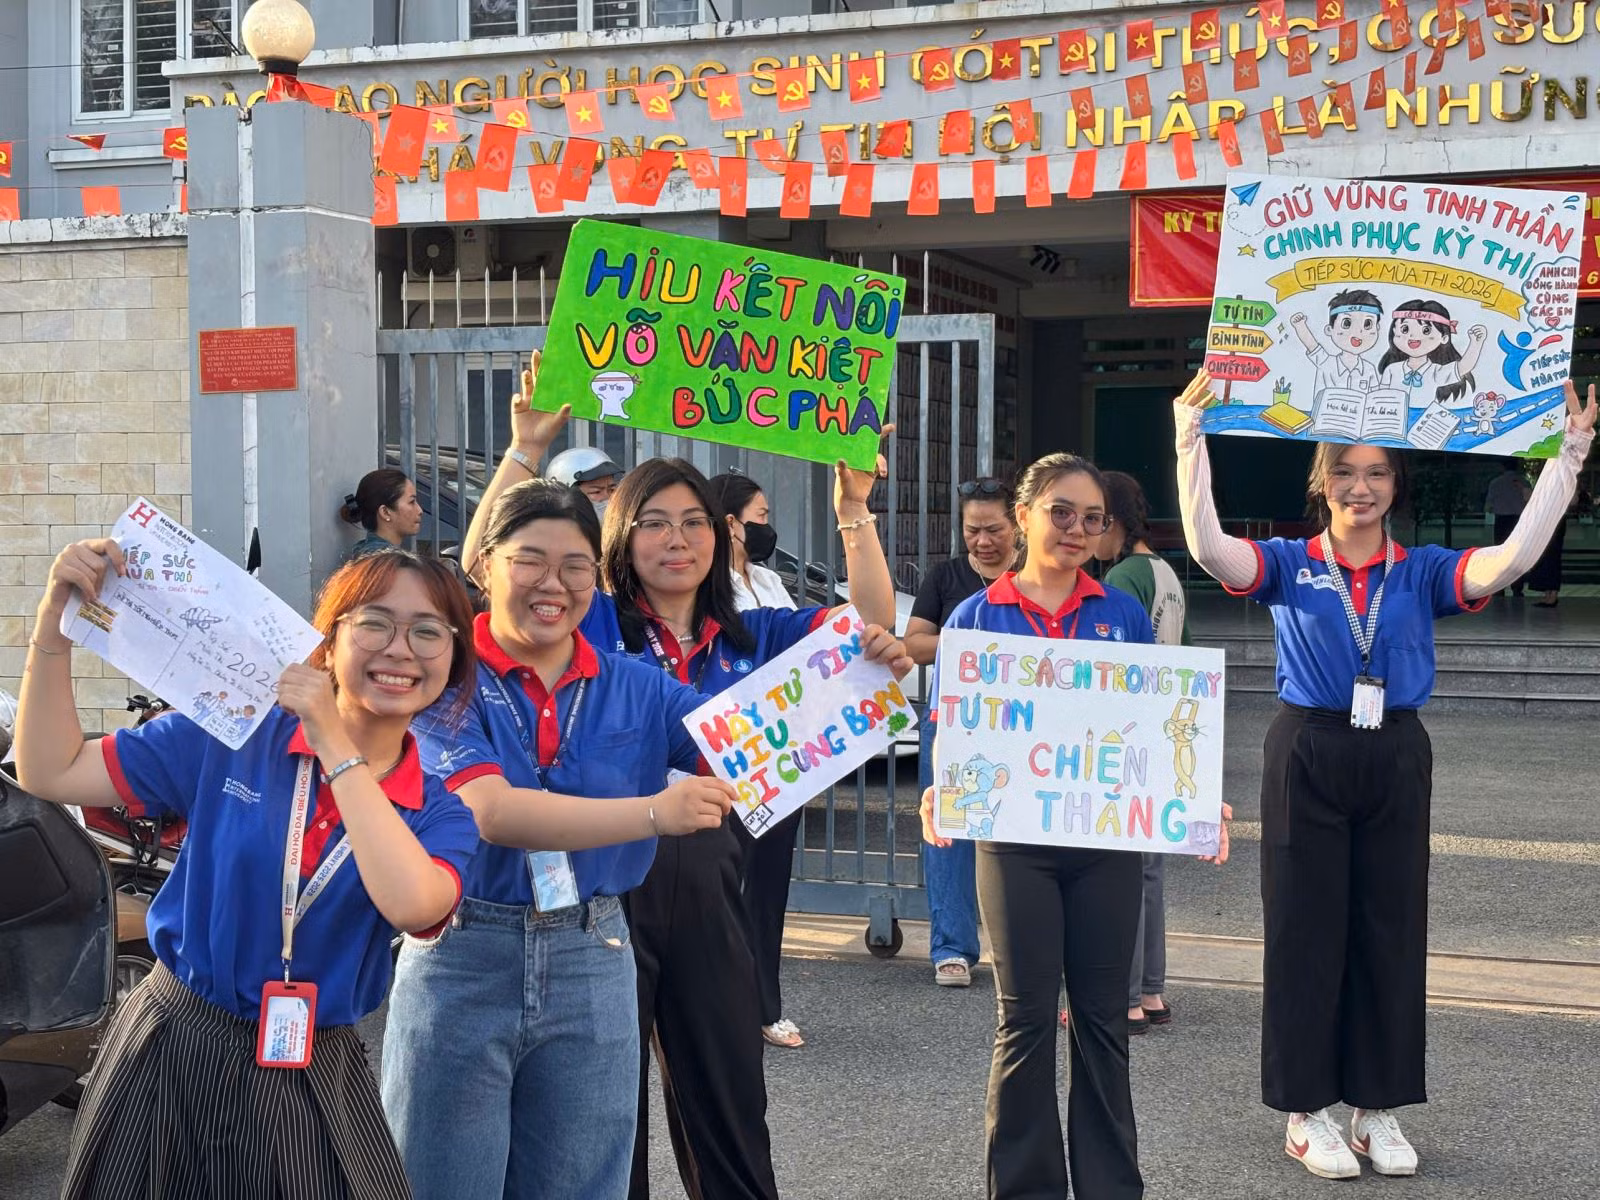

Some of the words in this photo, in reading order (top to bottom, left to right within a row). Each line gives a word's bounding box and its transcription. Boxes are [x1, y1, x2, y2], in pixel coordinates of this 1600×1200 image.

[1386, 65, 1600, 128] NHỮN
[1264, 183, 1314, 228] GIỮ
[1324, 180, 1407, 212] VŨNG
[1423, 187, 1487, 224] TINH
[1492, 203, 1574, 254] THẦN
[1264, 220, 1343, 260] CHINH
[1352, 220, 1420, 256] PHỤC
[1433, 225, 1474, 260] KỲ
[1482, 240, 1536, 280] THI
[1540, 267, 1560, 278] ANH
[585, 247, 701, 305] HIU
[713, 256, 807, 321] KẾT
[812, 273, 901, 339] NỐI
[1304, 259, 1335, 281] TIẾP
[1340, 258, 1374, 281] SỨC
[1380, 262, 1417, 284] MÙA
[1422, 270, 1448, 288] THI
[1449, 276, 1492, 300] 2026
[1536, 292, 1569, 304] CÙNG
[1223, 304, 1241, 322] TỰ
[1531, 303, 1553, 317] CÁC
[1557, 306, 1573, 316] EM
[576, 307, 662, 370] VÕ
[677, 319, 779, 374] VĂN
[788, 336, 883, 391] KIỆT
[1212, 331, 1239, 346] BÌNH
[1208, 359, 1240, 375] QUYẾT
[672, 372, 779, 429] BỨC
[788, 387, 882, 435] PHÁ
[128, 501, 157, 529] H
[123, 543, 150, 565] IẾP
[162, 551, 196, 569] SỨC
[126, 564, 155, 581] ÙA
[162, 569, 193, 583] THI
[700, 701, 764, 753] HÃY
[765, 667, 803, 712] TỰ
[806, 633, 864, 680] TIN
[960, 642, 1016, 684] BÚT
[1019, 648, 1092, 690] SÁCH
[1094, 661, 1172, 695] TRONG
[1175, 668, 1222, 698] TAY
[776, 724, 847, 783] CÙNG
[841, 680, 907, 736] BẠN
[940, 692, 981, 736] TỰ
[984, 697, 1034, 732] TIN
[722, 718, 789, 779] HIU
[1028, 722, 1148, 787] CHIẾN
[1035, 782, 1187, 843] THẮNG
